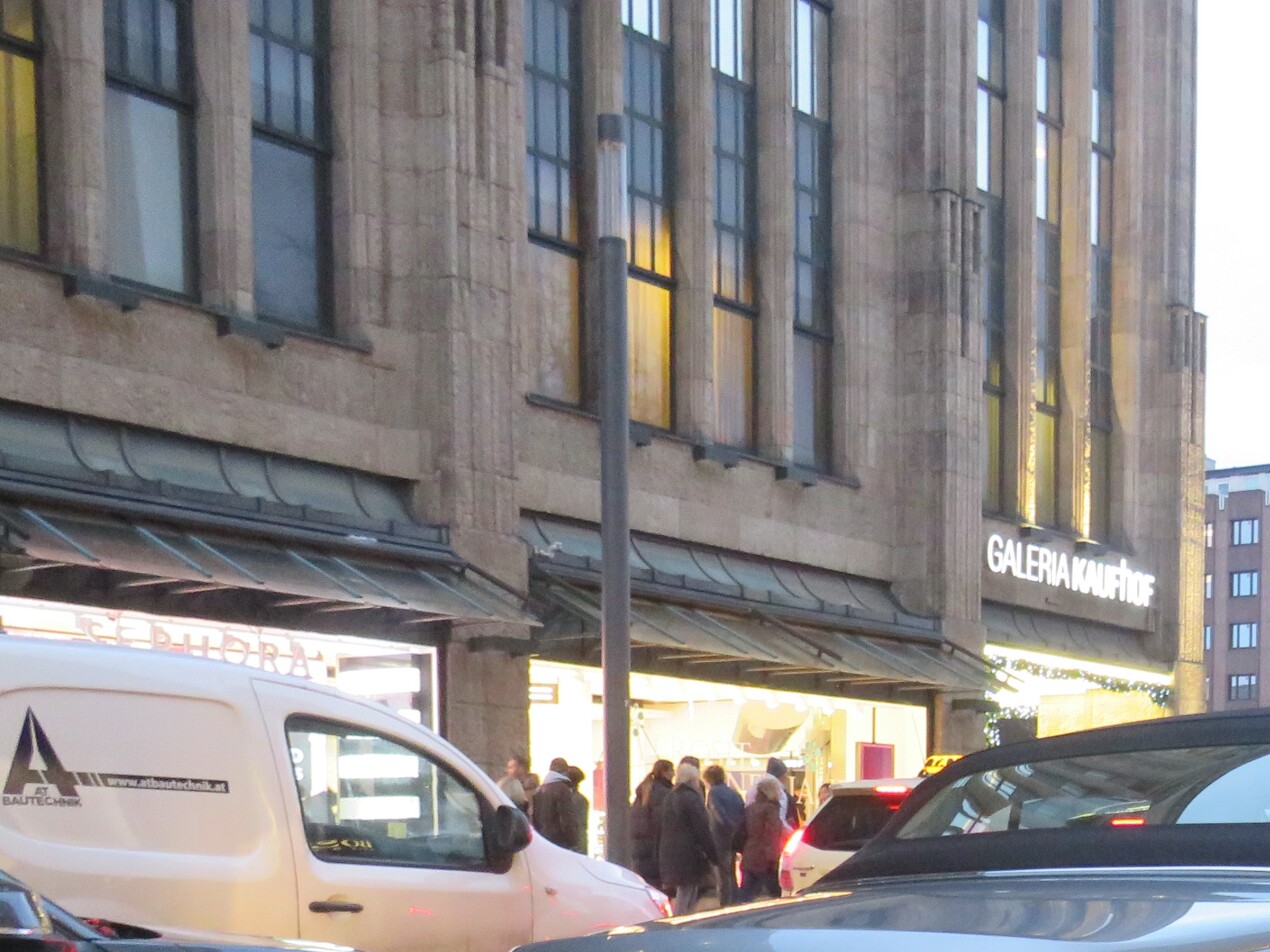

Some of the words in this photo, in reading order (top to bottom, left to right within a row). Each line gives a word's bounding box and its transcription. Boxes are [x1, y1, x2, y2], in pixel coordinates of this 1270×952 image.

[987, 534, 1070, 589] GALERIA
[107, 777, 226, 793] www.atbautechnik.at
[2, 795, 83, 808] BAUTECHNIK
